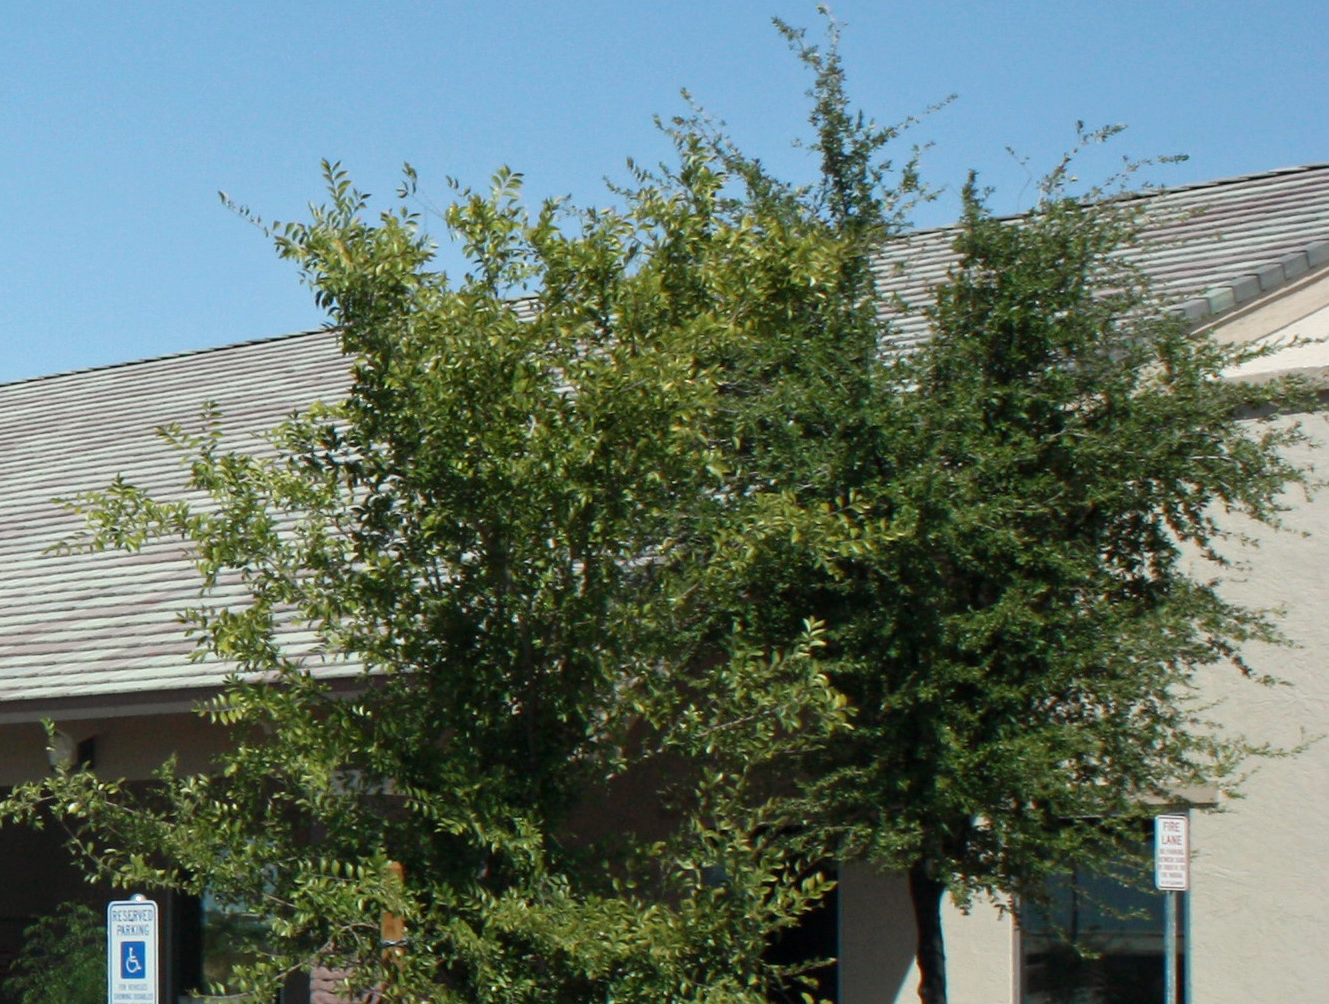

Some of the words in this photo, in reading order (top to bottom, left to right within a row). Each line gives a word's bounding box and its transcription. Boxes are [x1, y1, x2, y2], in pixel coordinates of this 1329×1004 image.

[1163, 822, 1180, 833] FIRE
[1161, 835, 1182, 846] LANE
[111, 909, 154, 922] RESERVED
[116, 923, 150, 937] PARKING
